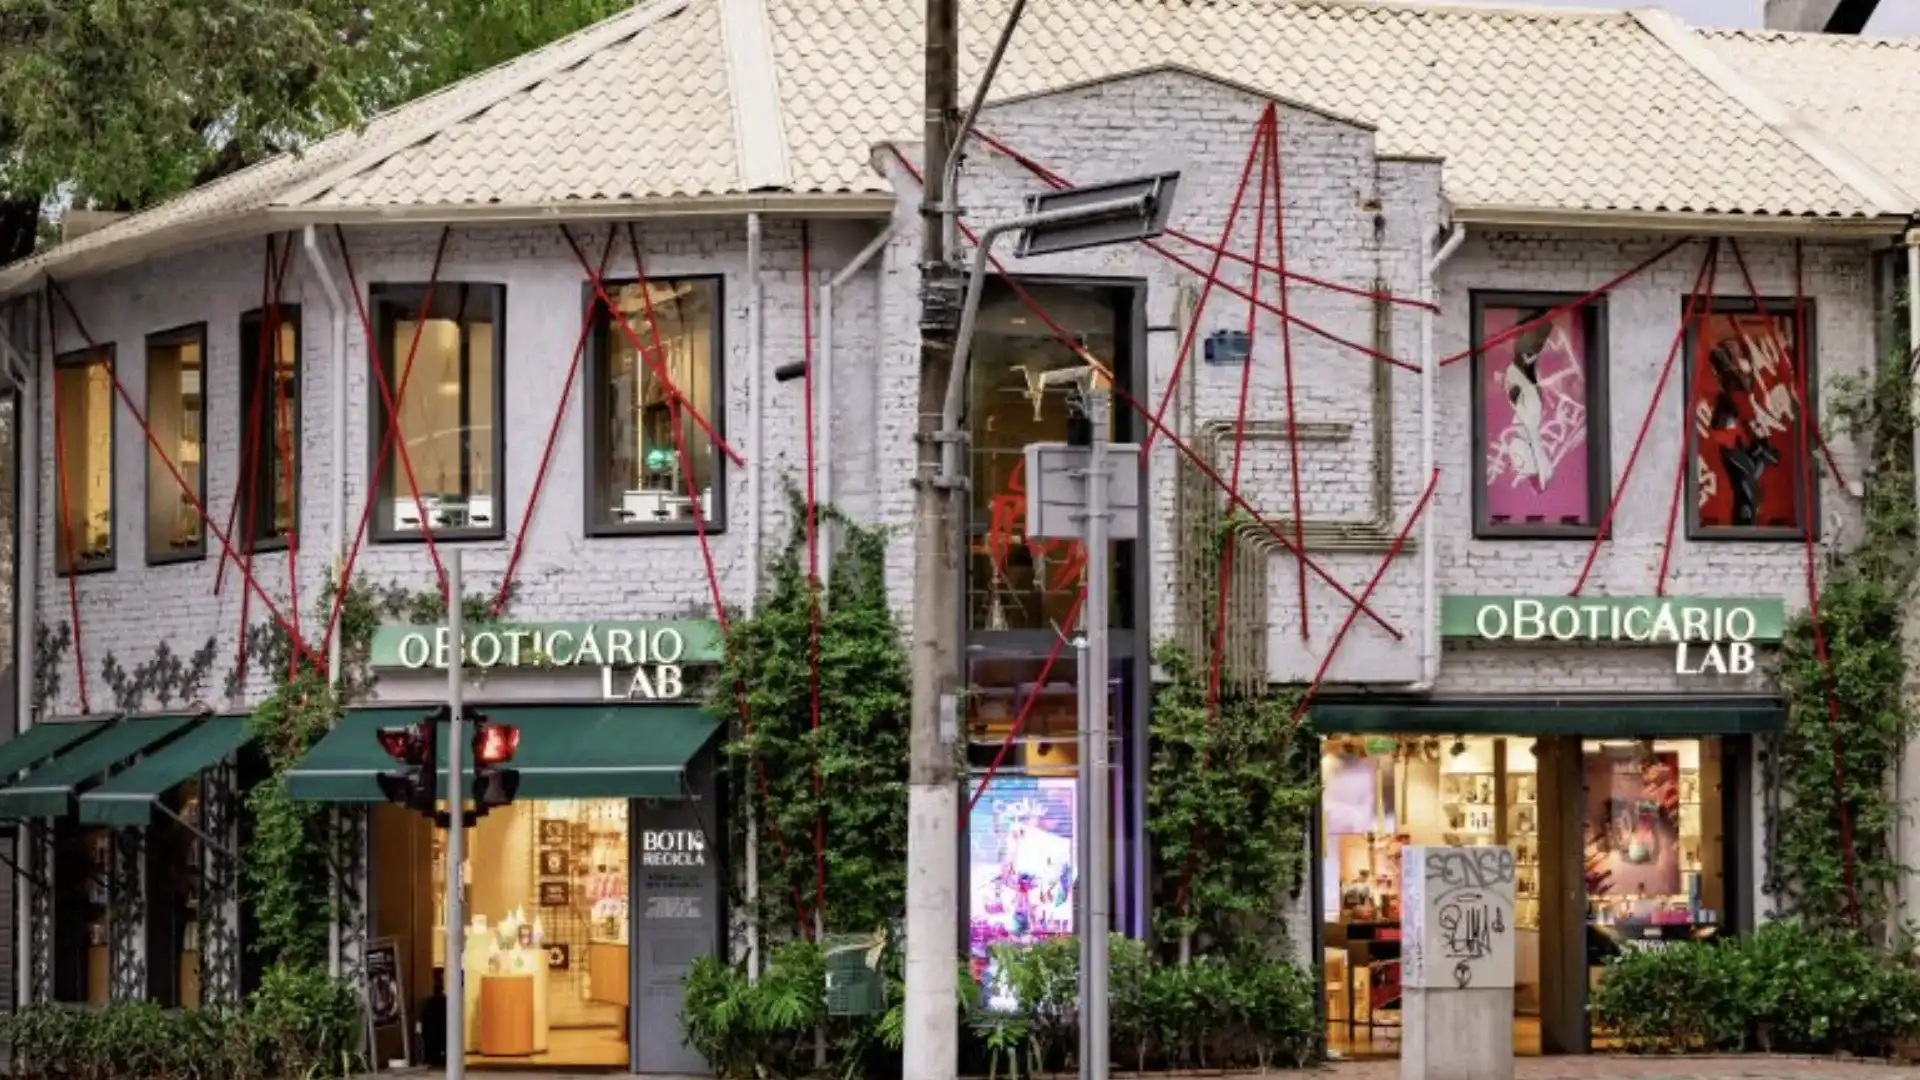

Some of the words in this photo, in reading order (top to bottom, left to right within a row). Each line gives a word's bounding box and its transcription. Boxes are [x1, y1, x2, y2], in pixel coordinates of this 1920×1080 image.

[1675, 642, 1755, 674] LAB
[602, 664, 684, 699] LAB
[643, 852, 705, 866] RECICLA
